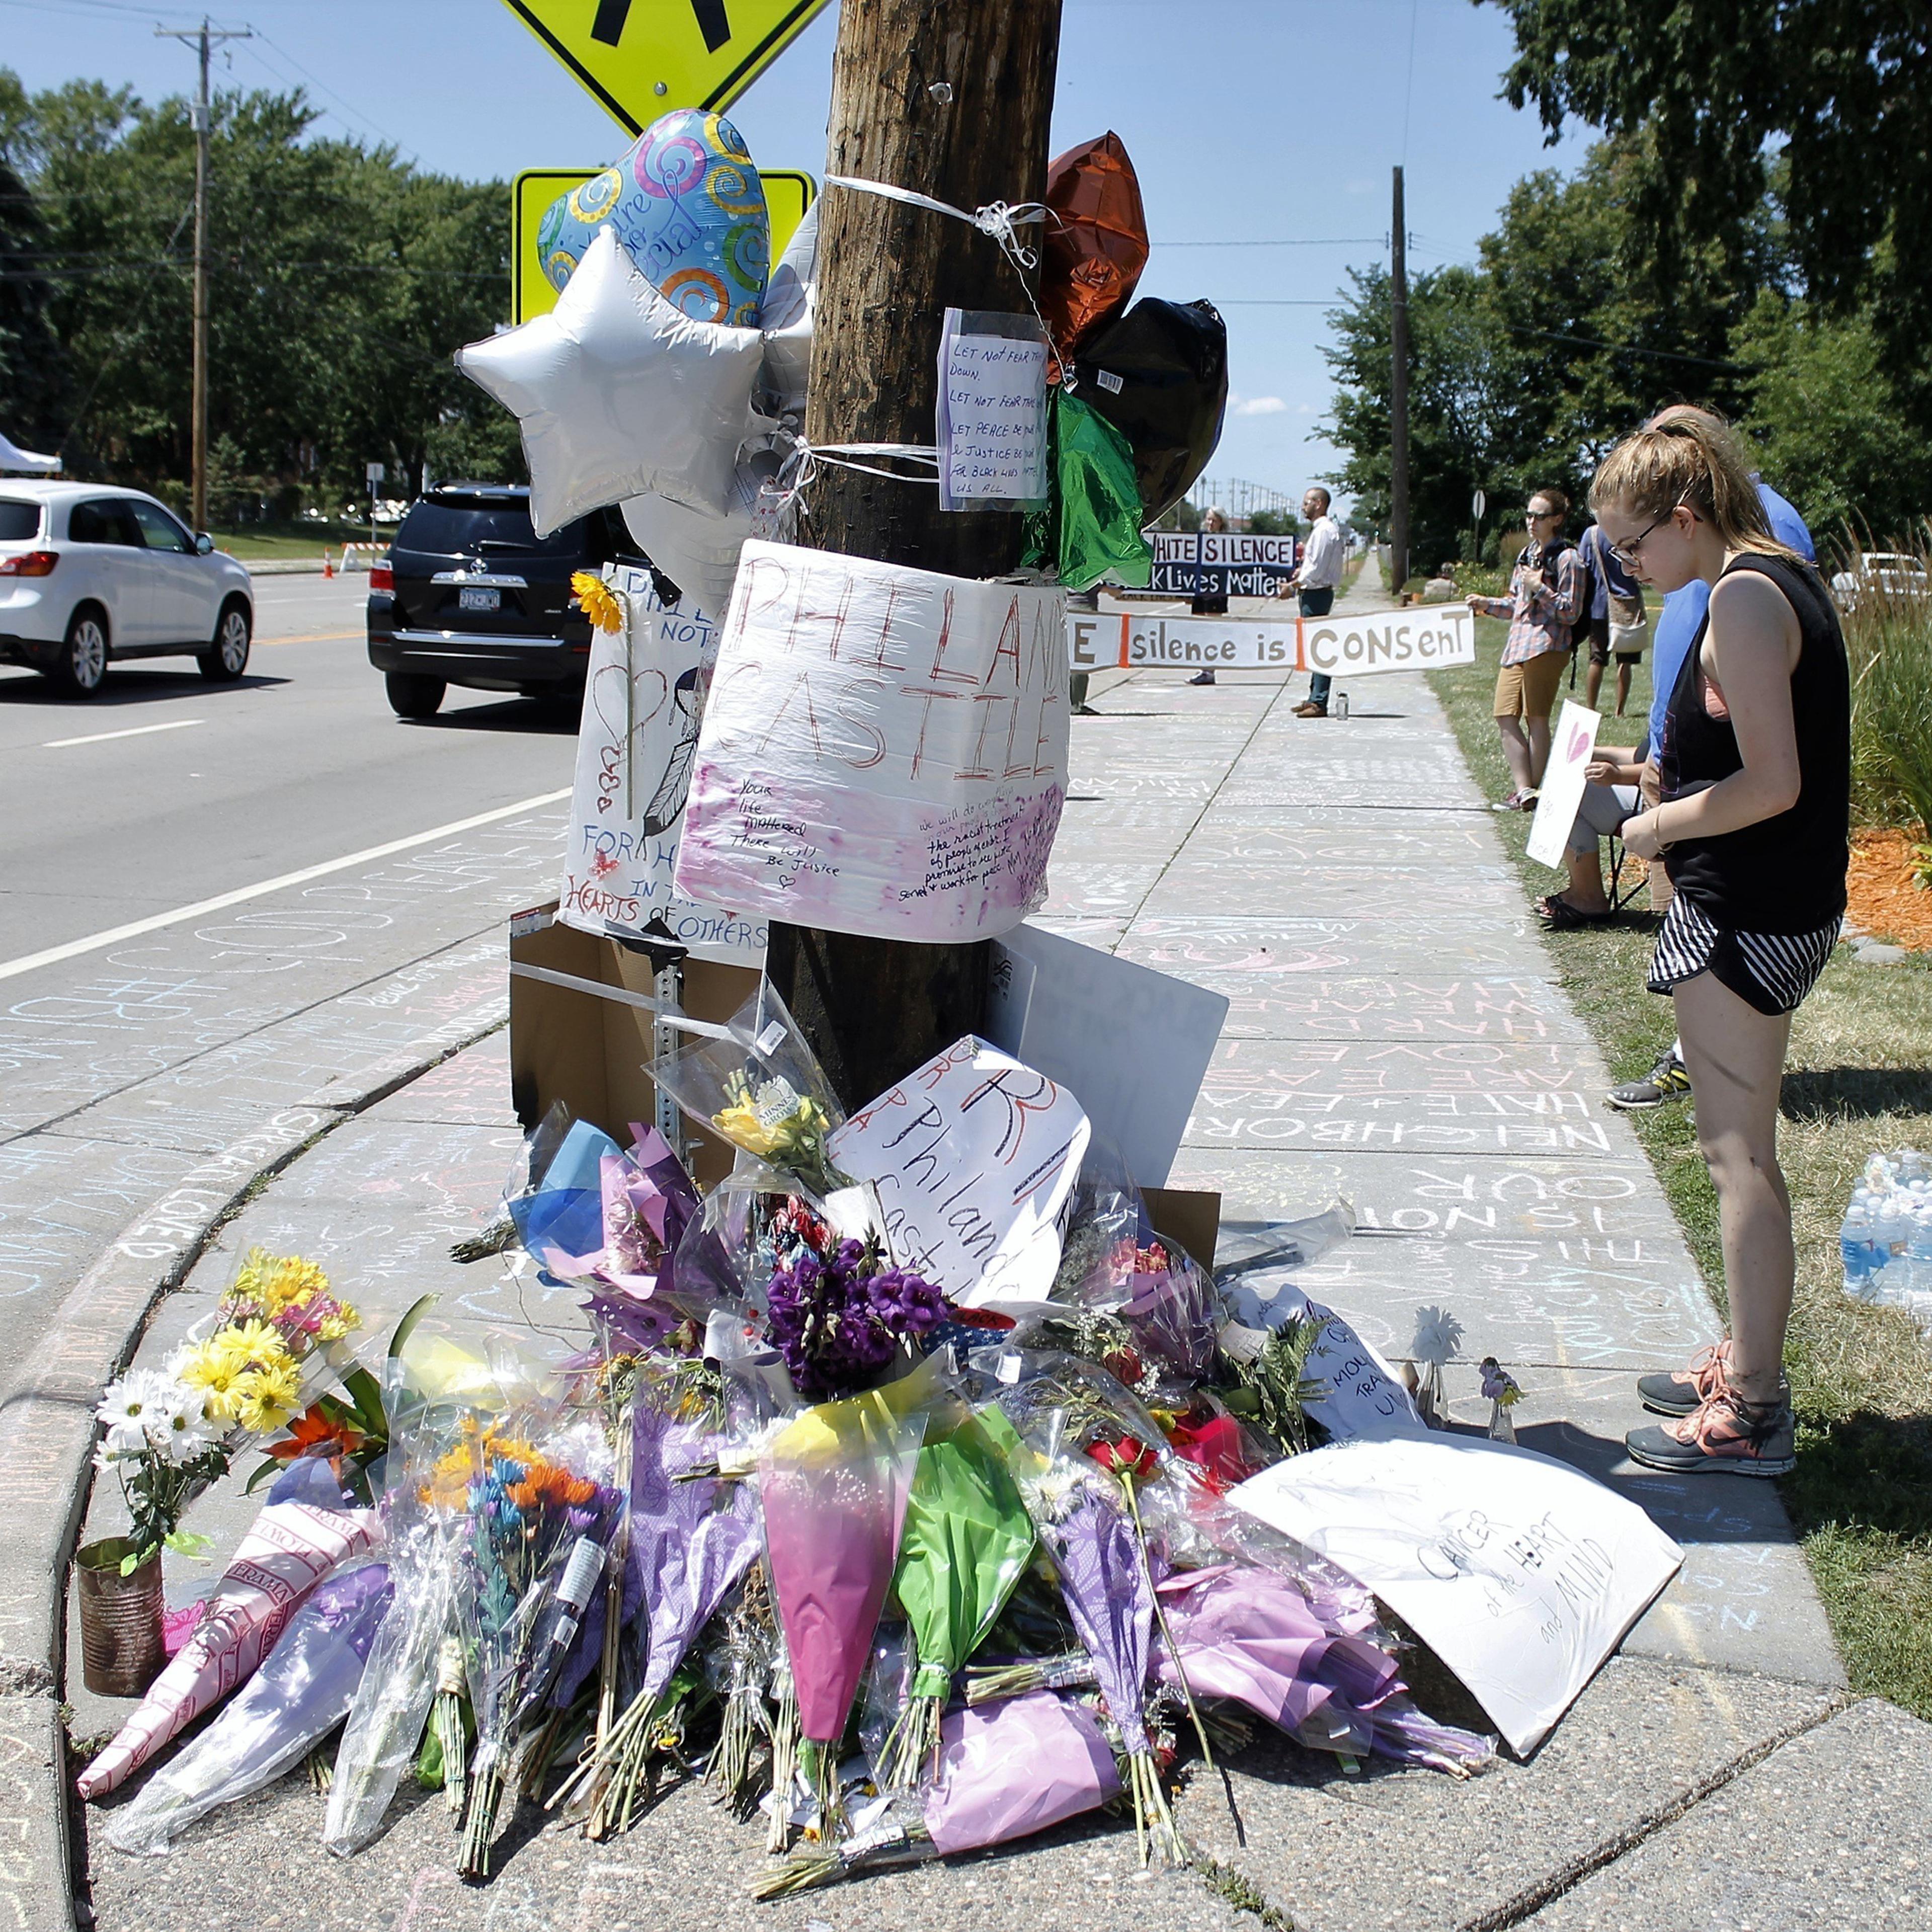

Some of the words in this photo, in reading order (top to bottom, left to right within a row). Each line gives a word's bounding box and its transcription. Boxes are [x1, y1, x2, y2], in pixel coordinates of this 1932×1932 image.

[954, 344, 978, 359] LET
[1007, 351, 1029, 363] FEAR
[950, 390, 971, 405] LET
[975, 396, 996, 408] NOT
[999, 395, 1021, 408] FEAR
[951, 423, 971, 437] LET
[976, 422, 1009, 437] PEACE
[1204, 539, 1292, 563] SILENCE
[1167, 567, 1220, 595] Lives
[1131, 621, 1237, 661] silence
[1257, 633, 1285, 661] is
[713, 661, 1058, 783] CASTILE
[739, 798, 762, 815] life
[939, 808, 957, 825] will
[963, 802, 975, 816] do
[583, 825, 635, 856] FOR
[927, 838, 951, 854] the
[631, 880, 657, 899] IN
[568, 874, 641, 923] HEARTS
[649, 906, 677, 925] OF
[677, 915, 768, 950] OTHERS
[1306, 1016, 1550, 1037] HARD
[1291, 1044, 1559, 1064] LOVE
[1204, 1068, 1387, 1088] EAS
[1424, 1068, 1574, 1089] ARE
[1200, 1092, 1344, 1111] FEA
[1420, 1092, 1589, 1117] HATE
[1408, 1168, 1637, 1200] OUR
[1464, 1237, 1668, 1264] THIS
[1417, 1509, 1512, 1582] CANCER
[1503, 1511, 1572, 1577] HEART
[1554, 1538, 1614, 1621] MIND
